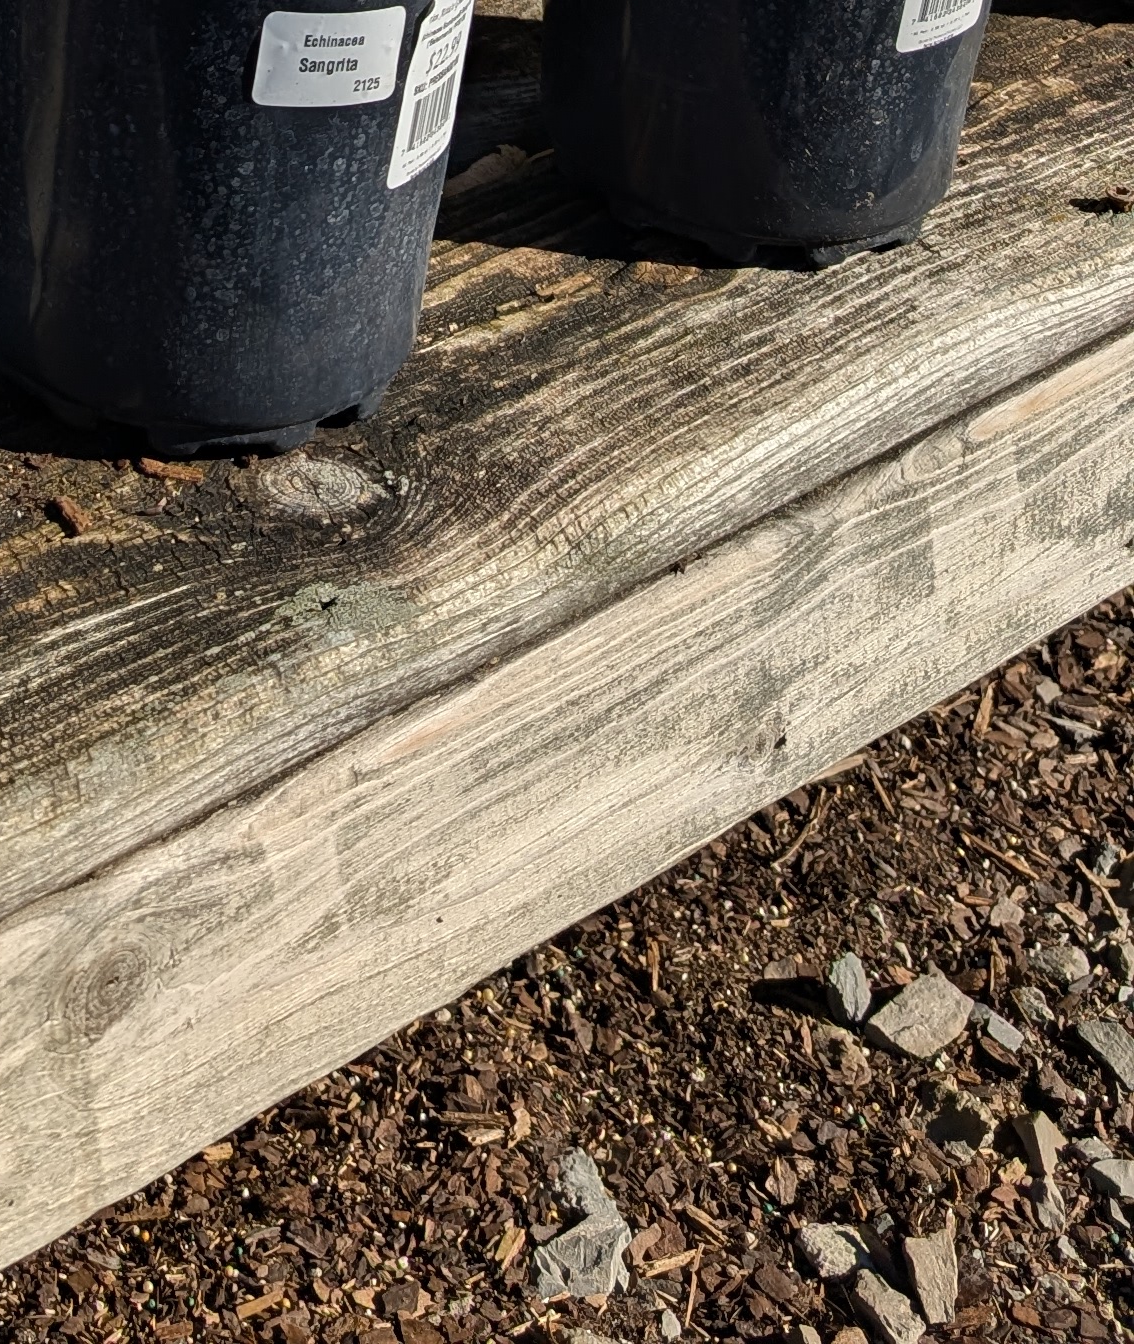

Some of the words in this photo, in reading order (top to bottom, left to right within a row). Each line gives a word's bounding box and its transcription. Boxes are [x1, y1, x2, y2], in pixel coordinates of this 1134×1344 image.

[303, 34, 365, 48] Echinacea
[425, 30, 463, 77] $22.99
[298, 57, 359, 75] Sangrita
[352, 77, 381, 93] 2125
